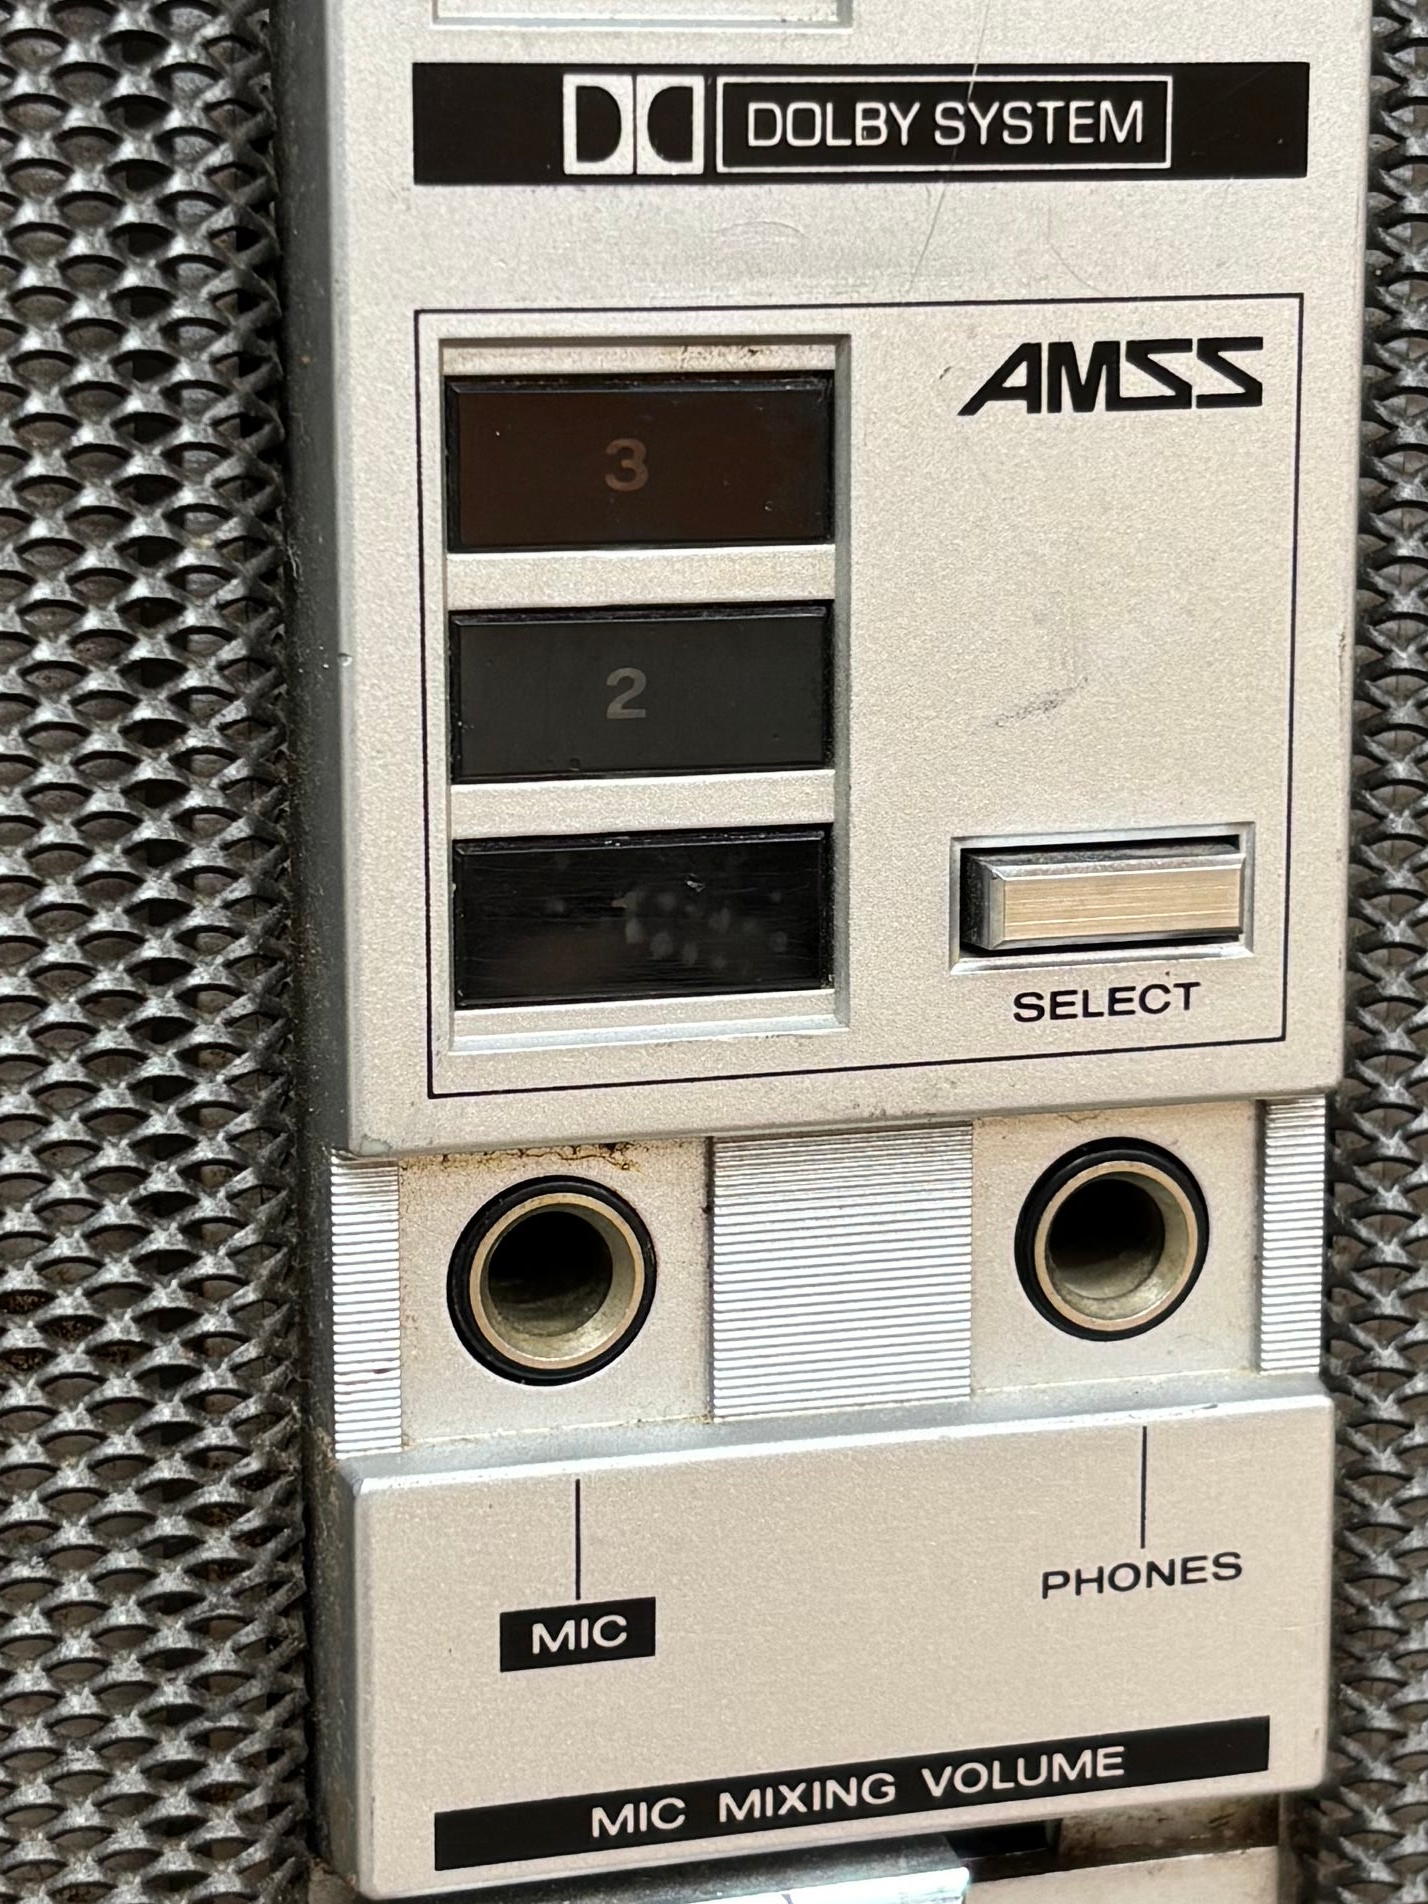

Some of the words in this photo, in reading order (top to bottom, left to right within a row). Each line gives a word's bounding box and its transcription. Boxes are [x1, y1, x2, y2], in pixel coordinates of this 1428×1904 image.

[748, 102, 920, 146] DOLBY
[935, 100, 1142, 145] SYSTEM
[957, 336, 1263, 416] AMSS
[604, 439, 649, 490] 3
[606, 667, 647, 719] 2
[1014, 982, 1201, 1022] SELECT
[1042, 1552, 1242, 1599] PHONES
[531, 1613, 629, 1655] MIC
[590, 1796, 686, 1838] MIC
[718, 1772, 896, 1820] MIXING
[923, 1745, 1125, 1797] VOLUME
